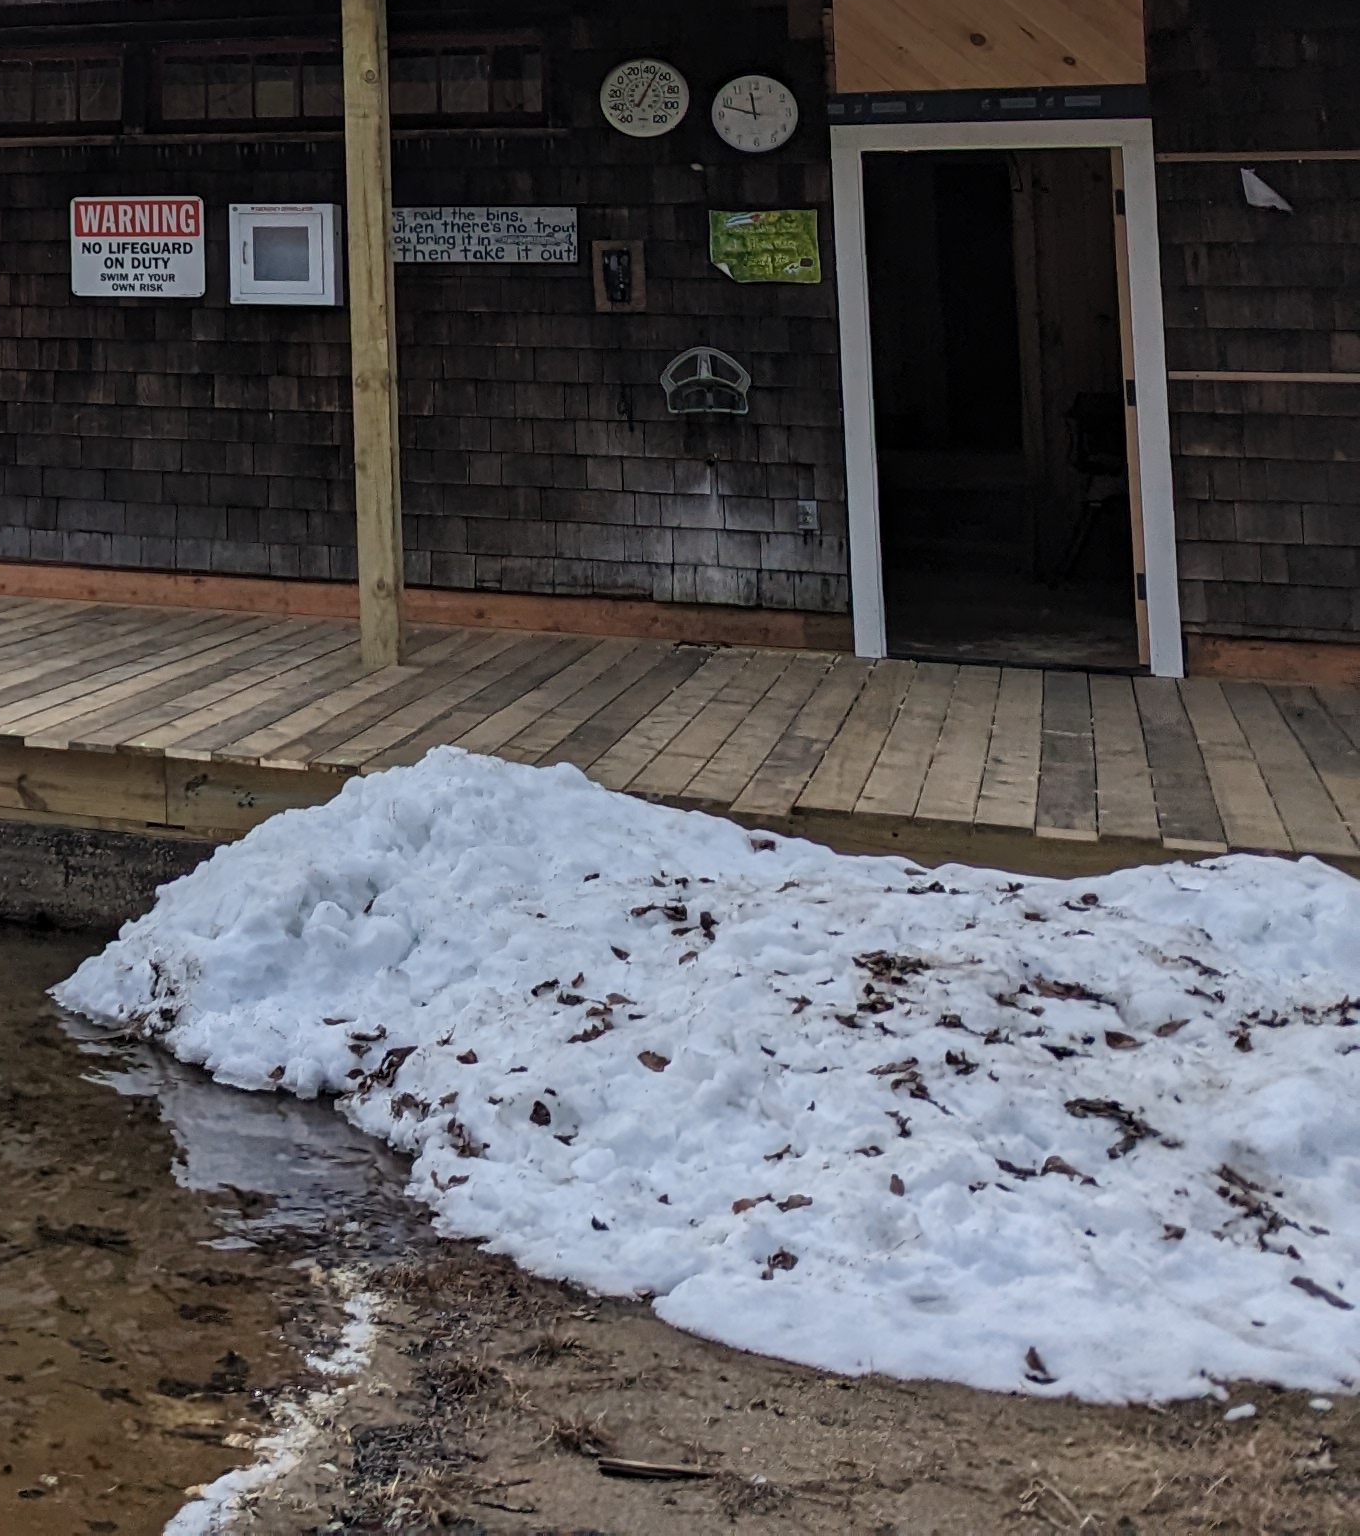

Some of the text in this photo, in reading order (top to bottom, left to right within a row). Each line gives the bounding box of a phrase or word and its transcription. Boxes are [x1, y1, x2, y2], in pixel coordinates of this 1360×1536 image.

[627, 67, 639, 76] 20
[643, 65, 656, 74] 40
[617, 75, 624, 84] 0
[658, 72, 671, 81] 60
[666, 85, 680, 94] 80
[664, 101, 679, 109] 100
[785, 107, 792, 117] 3
[653, 114, 667, 123] 120
[79, 203, 195, 234] WARNING
[414, 208, 442, 221] raid
[452, 209, 476, 221] the
[441, 220, 502, 234] there's
[506, 223, 527, 234] no
[533, 217, 577, 234] trout
[393, 233, 491, 249] ou bring it in
[81, 242, 193, 255] NO LIFEGUARD
[397, 245, 577, 262] then take it out!
[103, 256, 171, 270] ON DUTY
[100, 272, 176, 282] SWIM AT YOUR
[111, 283, 164, 292] OWN RISK
